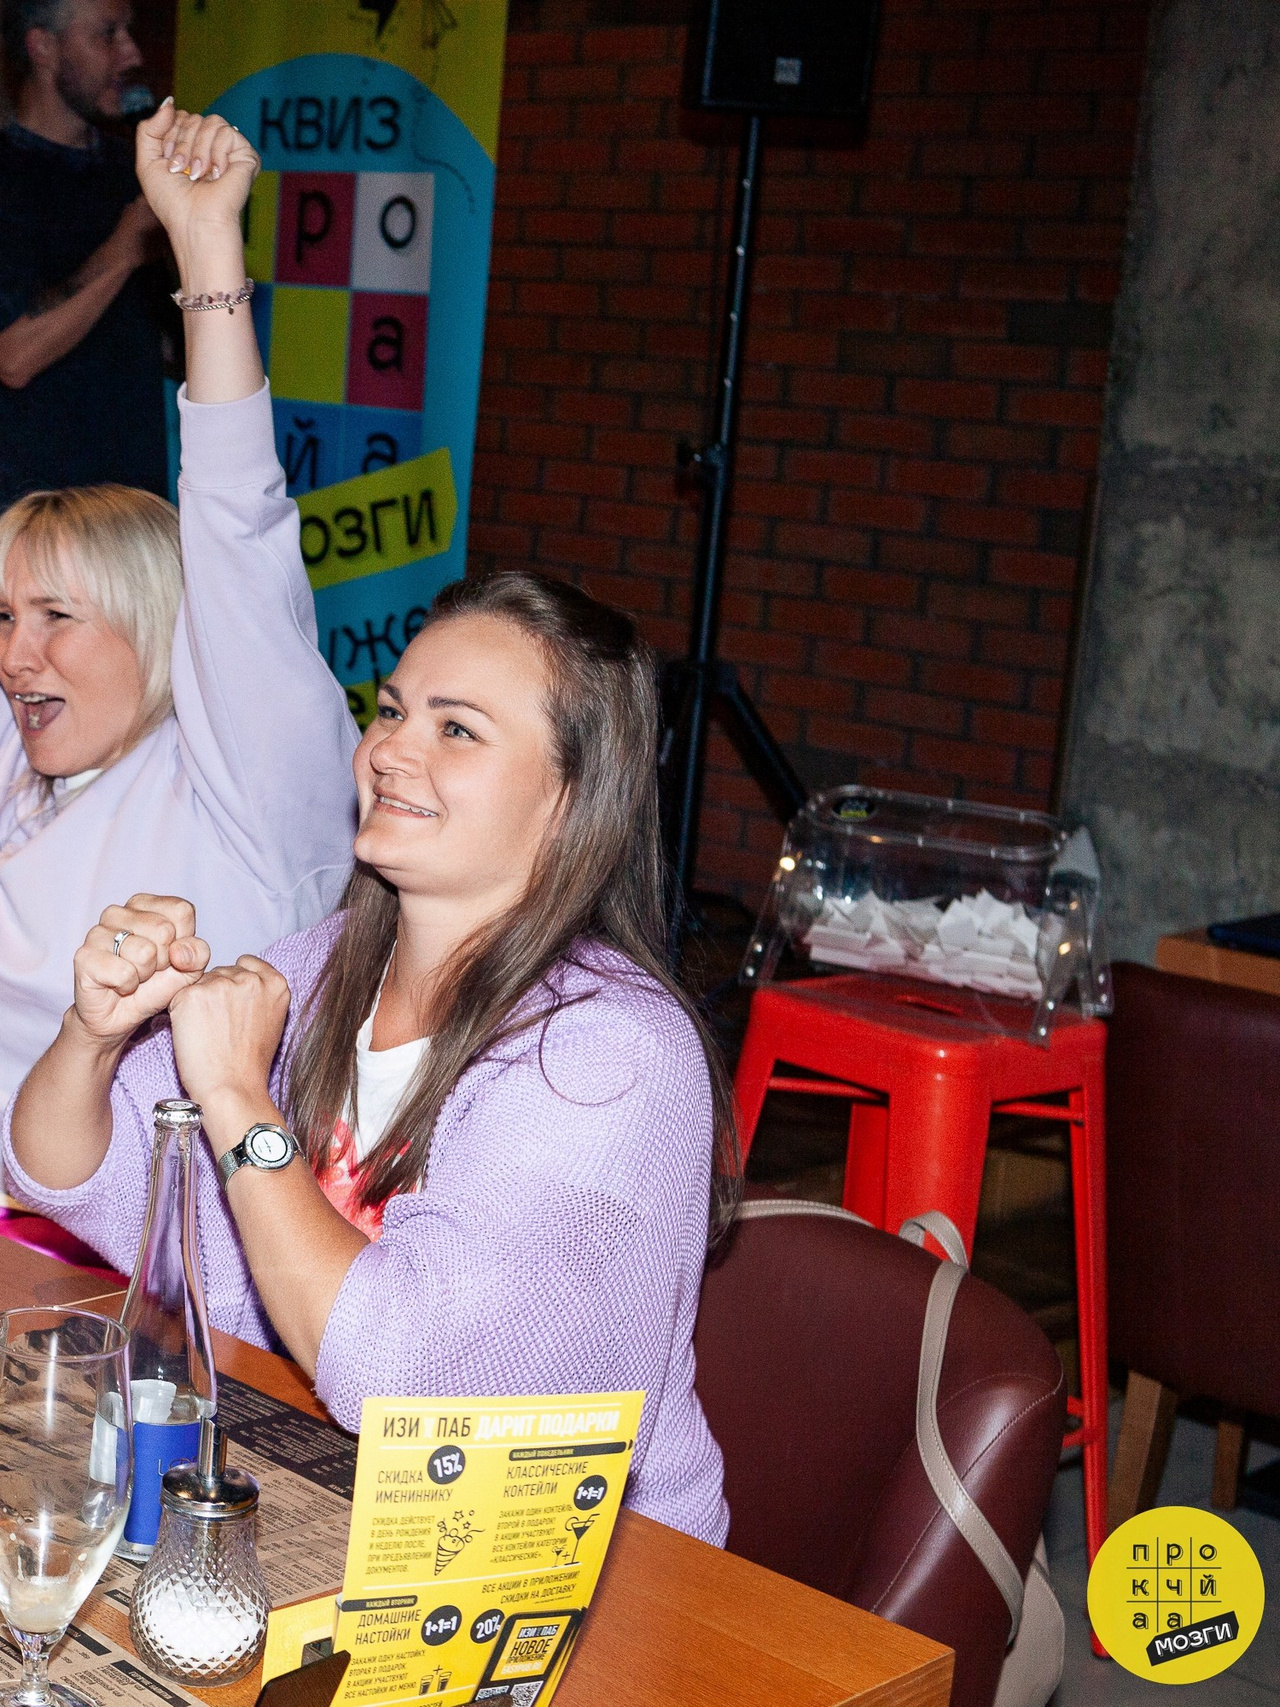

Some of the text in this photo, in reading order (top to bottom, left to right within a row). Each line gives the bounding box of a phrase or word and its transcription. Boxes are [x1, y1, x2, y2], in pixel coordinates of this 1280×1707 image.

[259, 95, 401, 152] КВИЗ
[300, 488, 439, 565] ОЗГИ
[383, 1410, 620, 1441] ИЗИ ПАБ ДАРИТ ПОДАРКИ
[433, 1452, 463, 1478] 15%
[507, 1461, 588, 1479] КЛАССИЧЕСКИЕ
[377, 1470, 423, 1485] СКИДКА
[375, 1488, 453, 1503] ИМЕНИННИКУ
[503, 1481, 558, 1498] КОКТЕЙЛИ
[576, 1486, 605, 1500] 1+1=1
[481, 1583, 497, 1593] ВСЕ
[498, 1580, 521, 1592] АКЦИИ
[500, 1592, 529, 1604] СКИДКИ
[541, 1583, 577, 1598] ДОСТАВКУ
[357, 1609, 422, 1629] ДОМАШНИЕ
[425, 1615, 458, 1636] 1+1=1
[476, 1615, 501, 1639] 20%
[355, 1627, 411, 1645] НАСТОЙКИ
[518, 1625, 558, 1638] ИЗИ ПАБ
[510, 1638, 553, 1657] НОВОЕ
